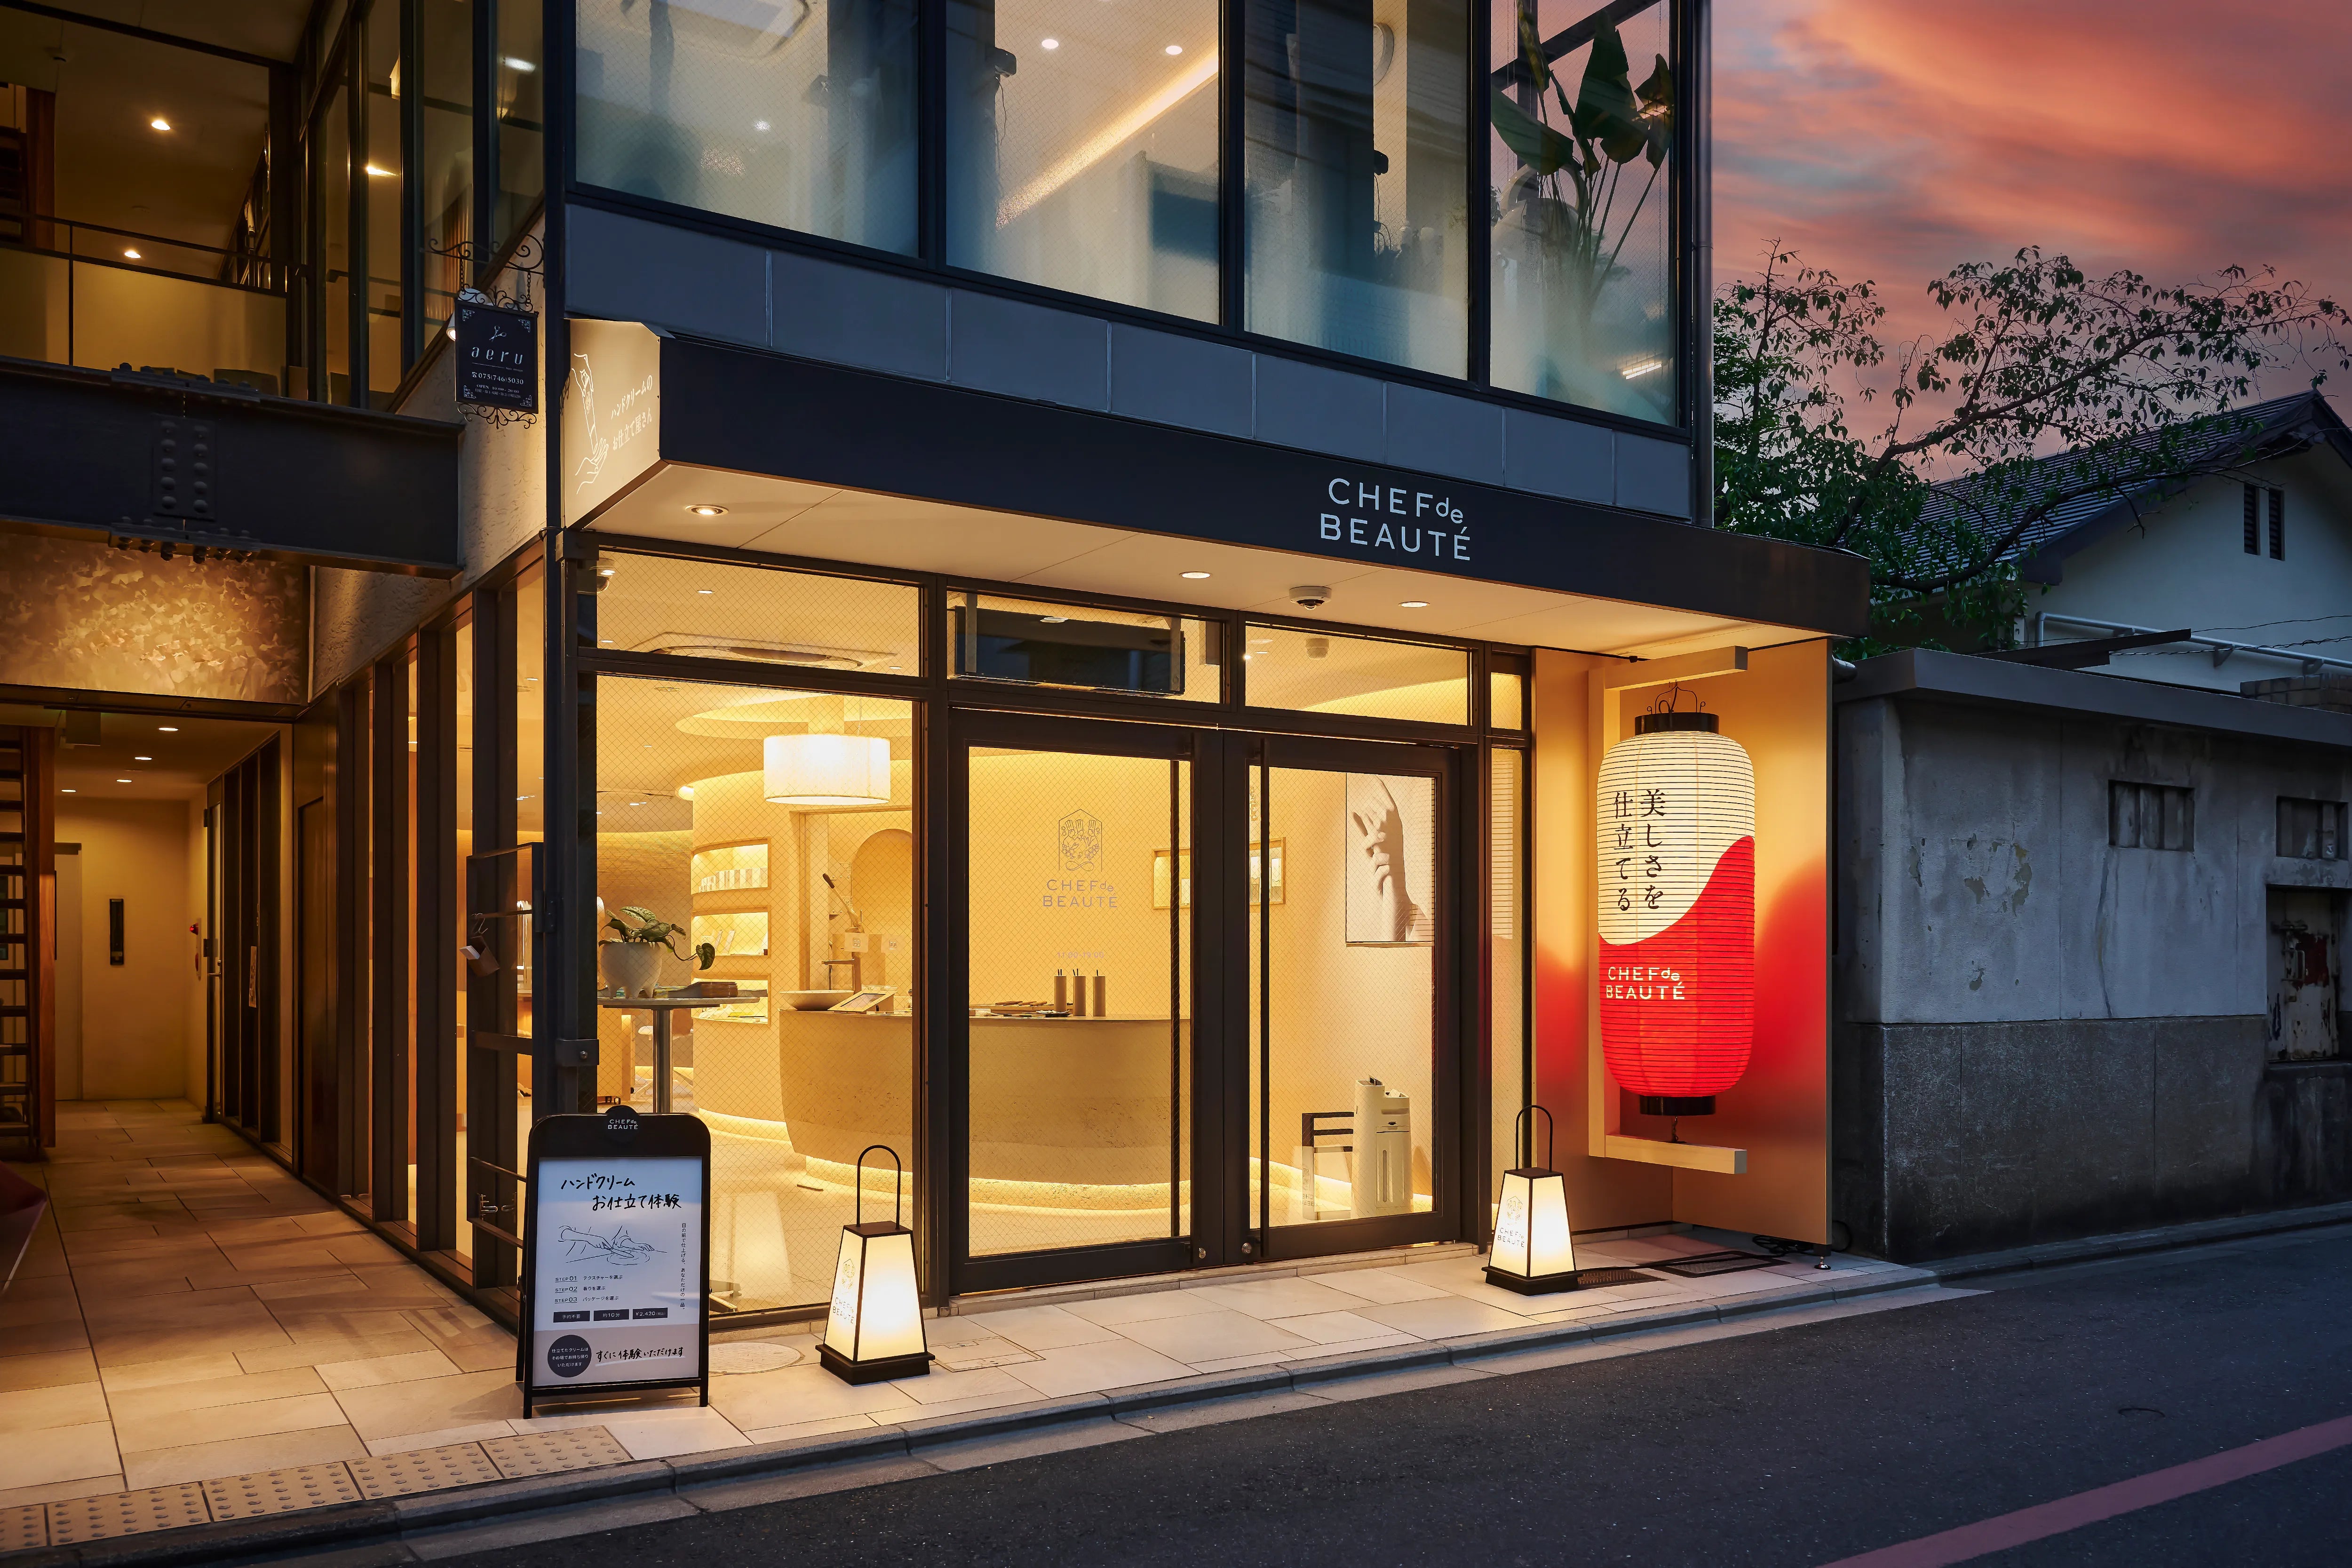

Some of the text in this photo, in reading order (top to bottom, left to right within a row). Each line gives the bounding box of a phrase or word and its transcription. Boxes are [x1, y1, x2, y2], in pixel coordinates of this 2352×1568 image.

[471, 347, 523, 365] aeru
[611, 375, 652, 420] ハンドクリームの
[613, 407, 652, 451] お仕立て屋さん
[1320, 513, 1470, 561] BEAUTÉ
[1613, 791, 1633, 911] 仕立てる
[1639, 788, 1666, 909] 美しさを
[1042, 892, 1118, 908] BEAUTÉ
[1605, 982, 1685, 1000] BEAUTÉ
[561, 1173, 636, 1190] ハンドクリーム
[592, 1193, 682, 1211] お仕立て体験
[596, 1346, 683, 1362] すぐに体験いただけます
